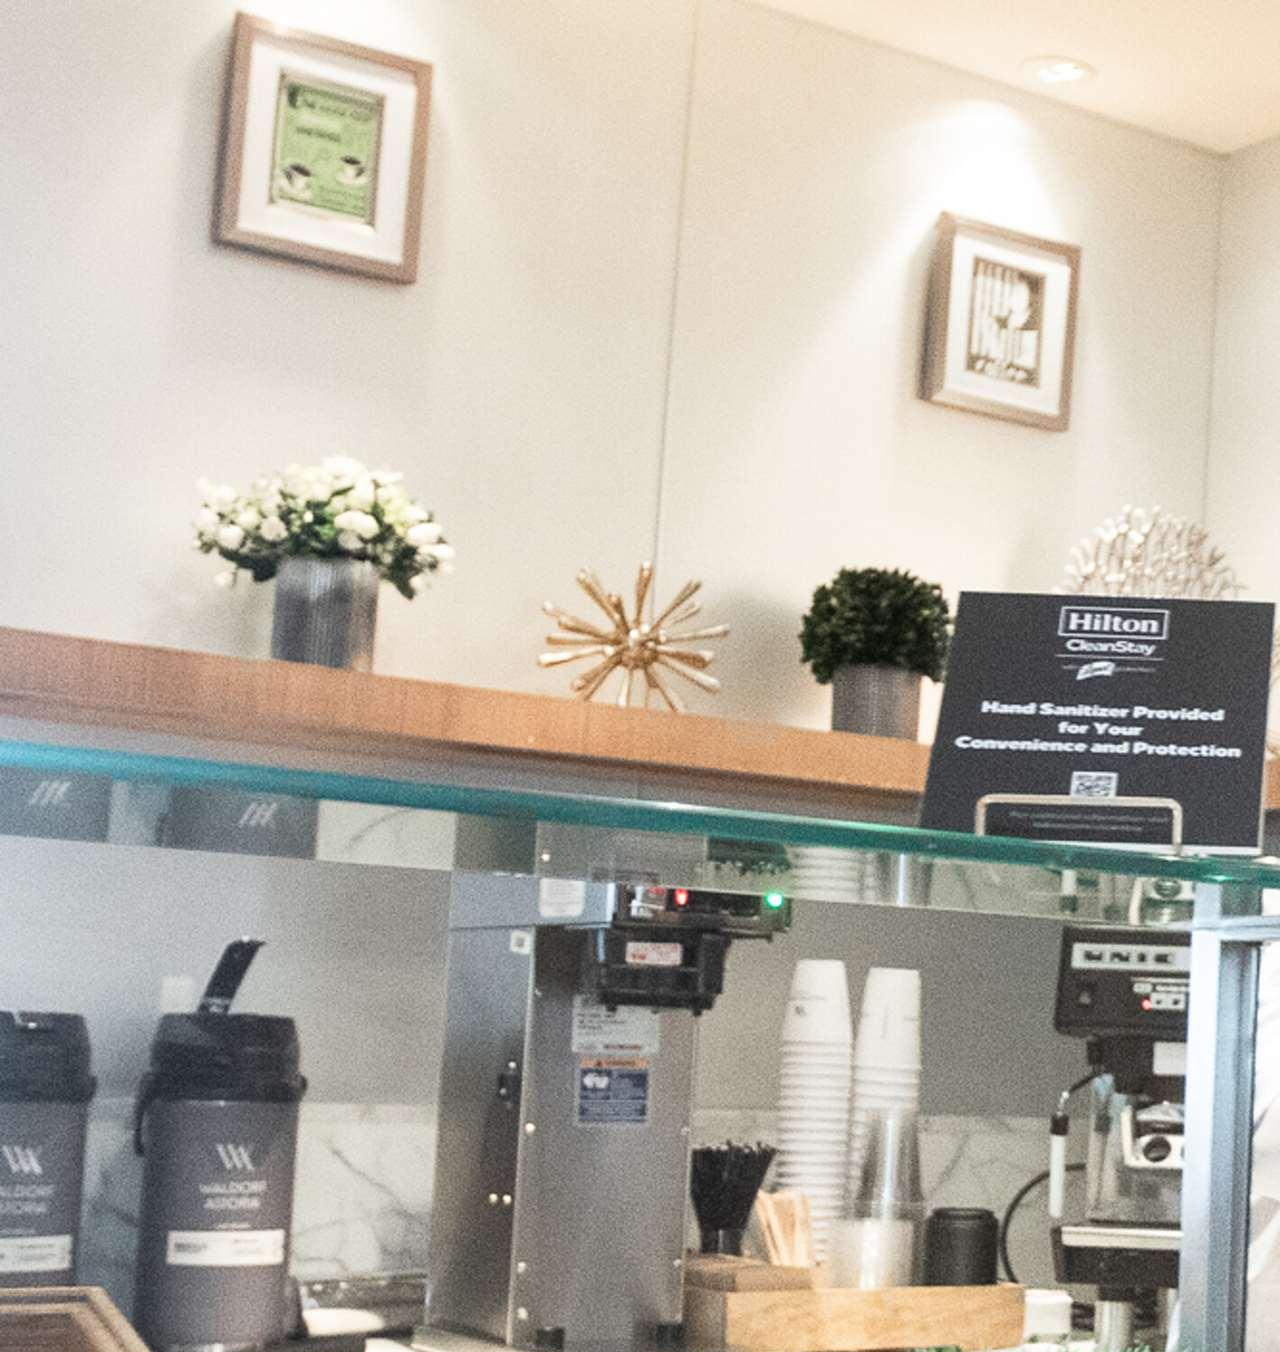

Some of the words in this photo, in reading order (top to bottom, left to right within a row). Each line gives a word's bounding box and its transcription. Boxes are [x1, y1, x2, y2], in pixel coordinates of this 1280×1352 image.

[1068, 612, 1159, 633] Hilton
[1066, 639, 1156, 656] CleanStay
[981, 701, 1037, 715] Hand
[1039, 702, 1129, 718] Sanitizer
[1133, 706, 1225, 721] Provided
[1058, 721, 1090, 735] for
[1094, 722, 1144, 736] Your
[954, 735, 1089, 752] Convenience
[1090, 741, 1130, 754] and
[1133, 742, 1242, 758] Protection
